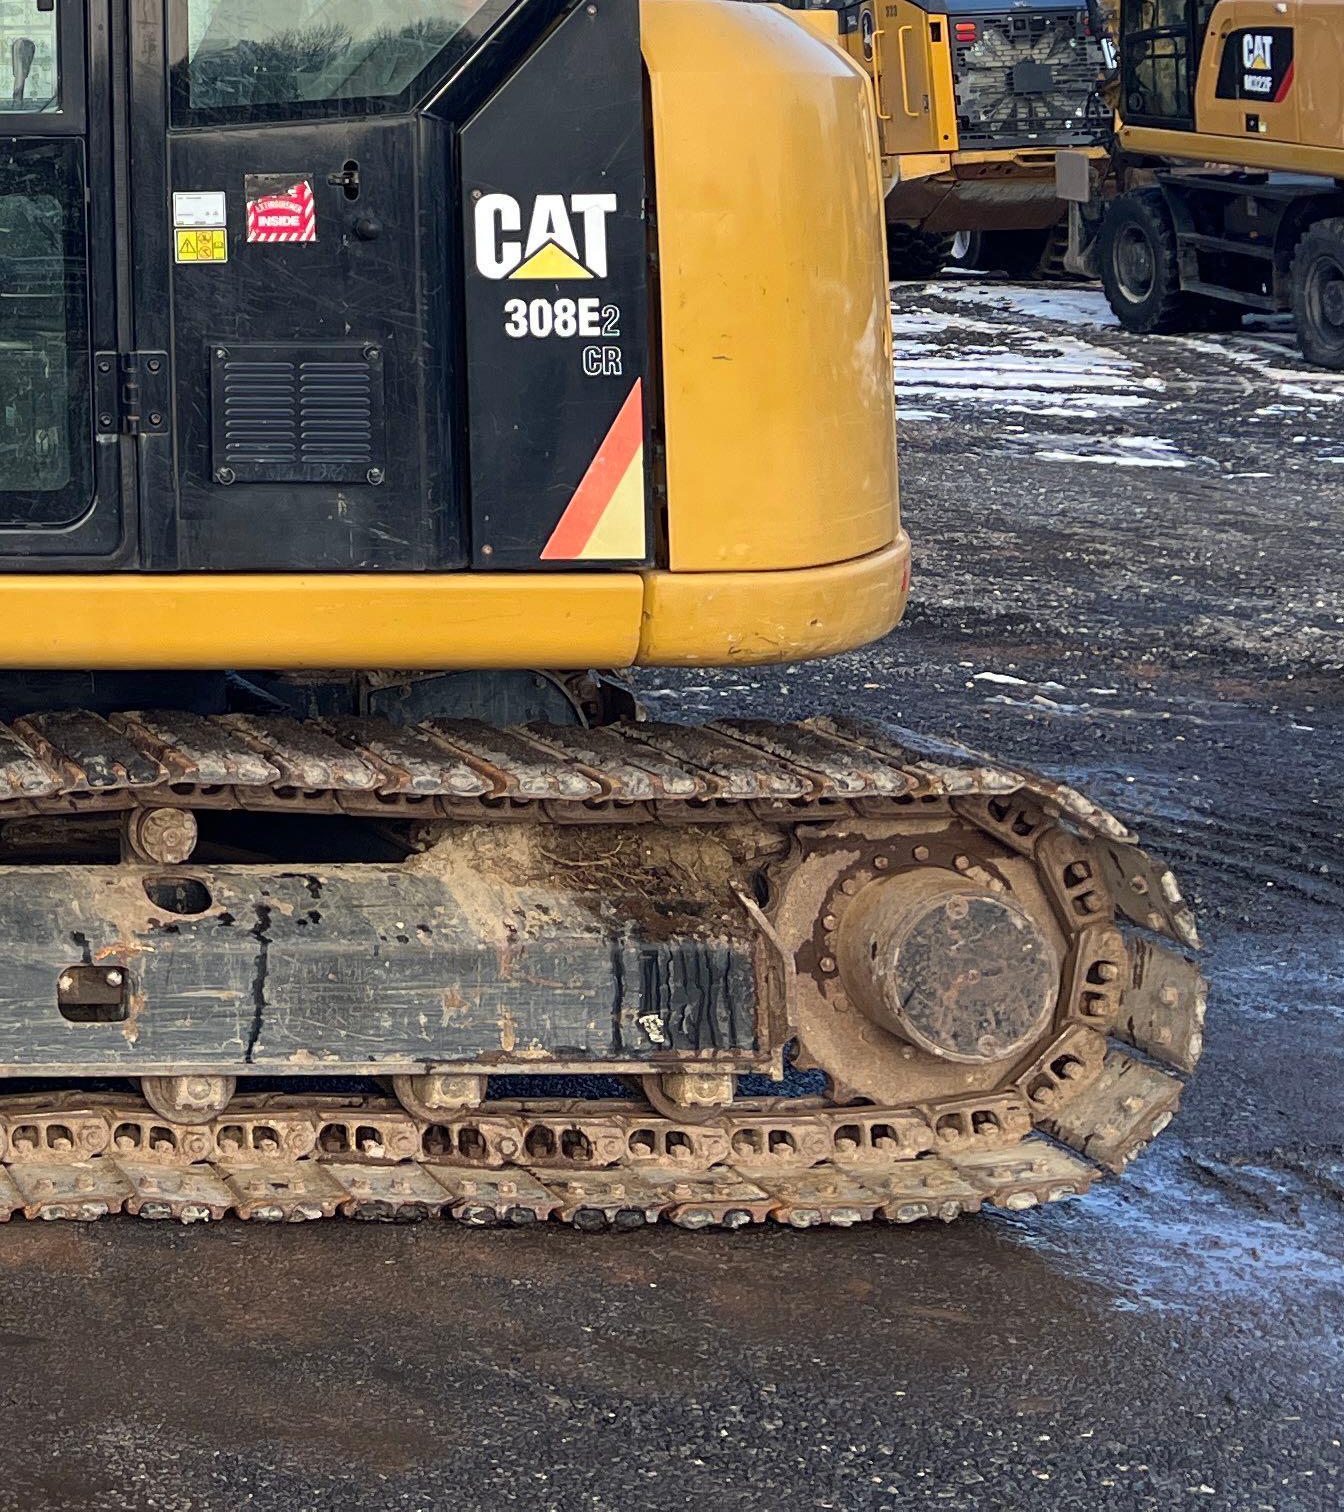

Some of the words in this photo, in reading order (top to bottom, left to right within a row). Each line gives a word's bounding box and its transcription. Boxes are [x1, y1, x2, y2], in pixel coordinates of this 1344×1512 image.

[1243, 34, 1273, 69] CAT
[258, 215, 300, 227] INSIDE
[475, 193, 617, 279] CAT
[582, 345, 623, 376] CR
